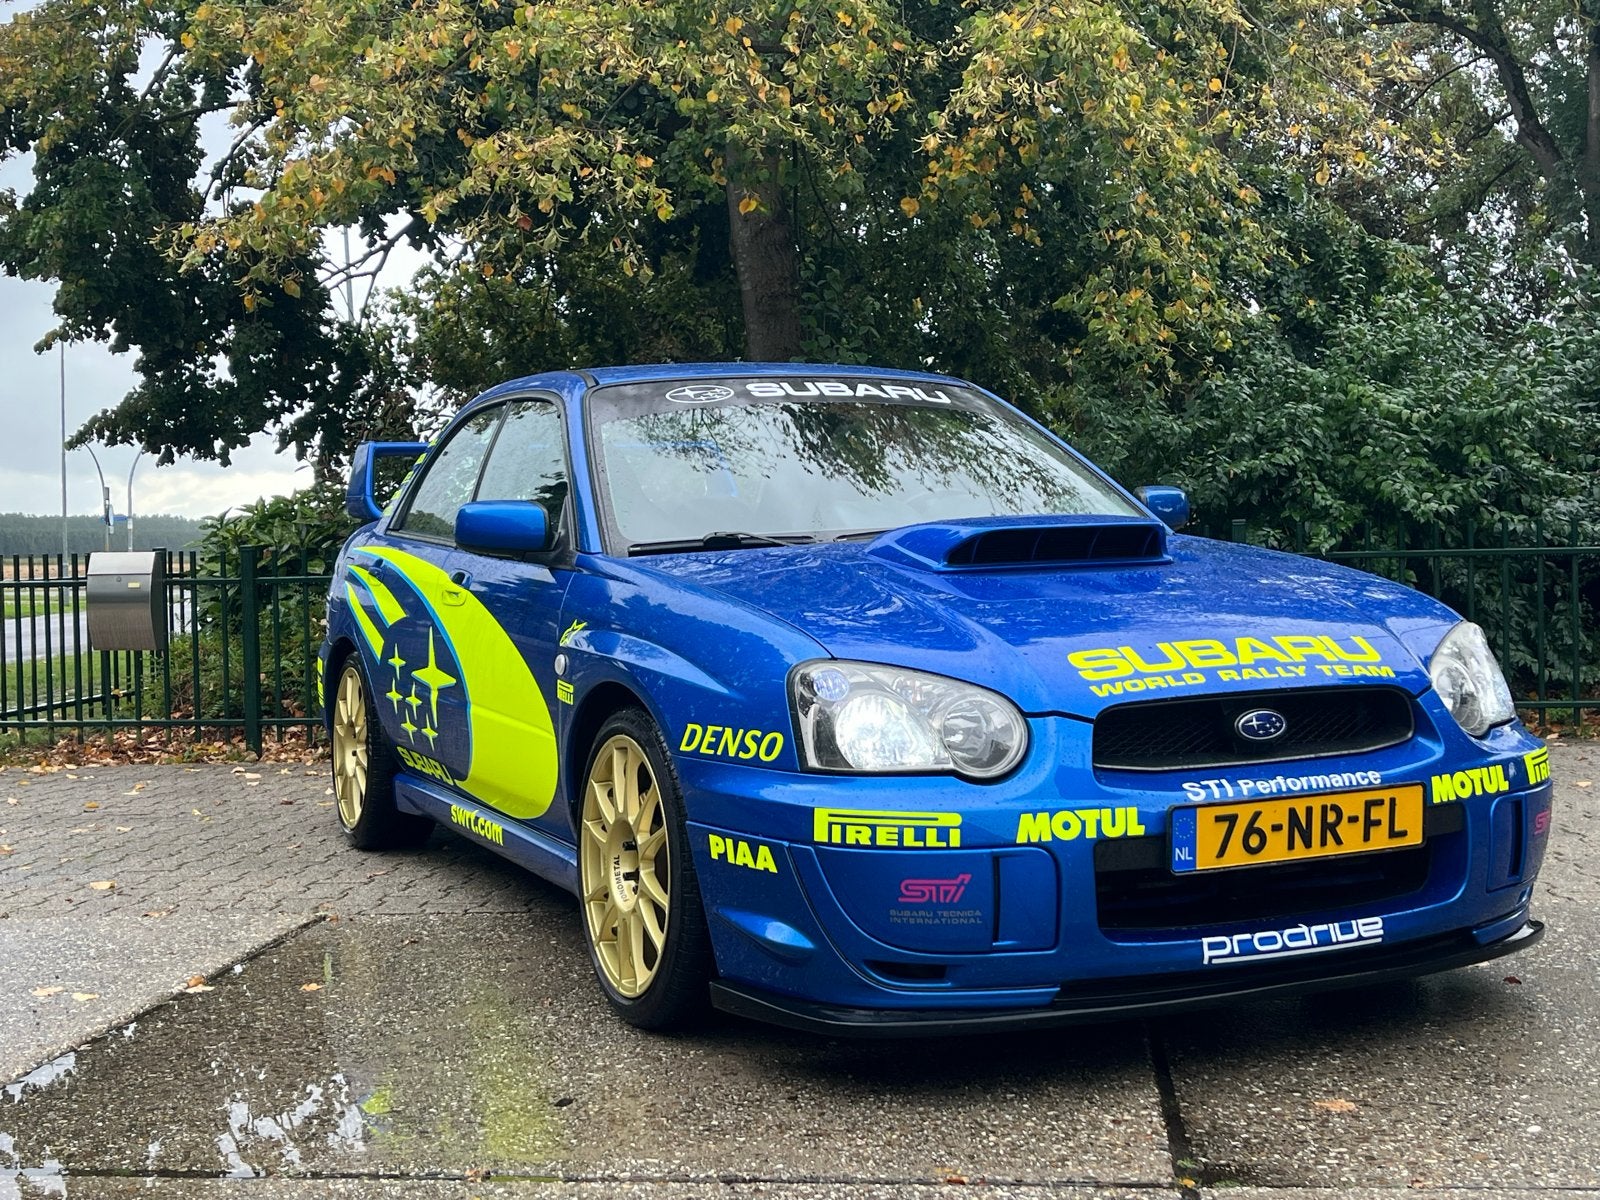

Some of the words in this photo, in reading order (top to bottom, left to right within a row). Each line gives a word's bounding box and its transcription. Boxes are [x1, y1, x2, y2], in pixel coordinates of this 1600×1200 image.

[746, 382, 951, 404] SUBARU
[1067, 635, 1382, 681] SUBARU
[1089, 672, 1206, 698] WORLD
[1218, 665, 1307, 682] RALLY
[1315, 664, 1396, 679] TEAM
[680, 723, 784, 762] DENSO
[1182, 778, 1234, 802] STI
[1238, 769, 1382, 797] Performance
[1431, 764, 1509, 804] MOTUL
[450, 804, 504, 846] swrt.com
[813, 807, 963, 848] PIRELLI
[1016, 806, 1146, 844] MOTUL
[1213, 796, 1409, 860] 76-NR-FL
[708, 833, 778, 874] PIAA
[1175, 846, 1194, 862] NL
[889, 909, 934, 918] SUBARU
[936, 909, 983, 918] TECNICA
[889, 916, 983, 925] INTERNATIONAL
[1201, 916, 1384, 965] prodrive
